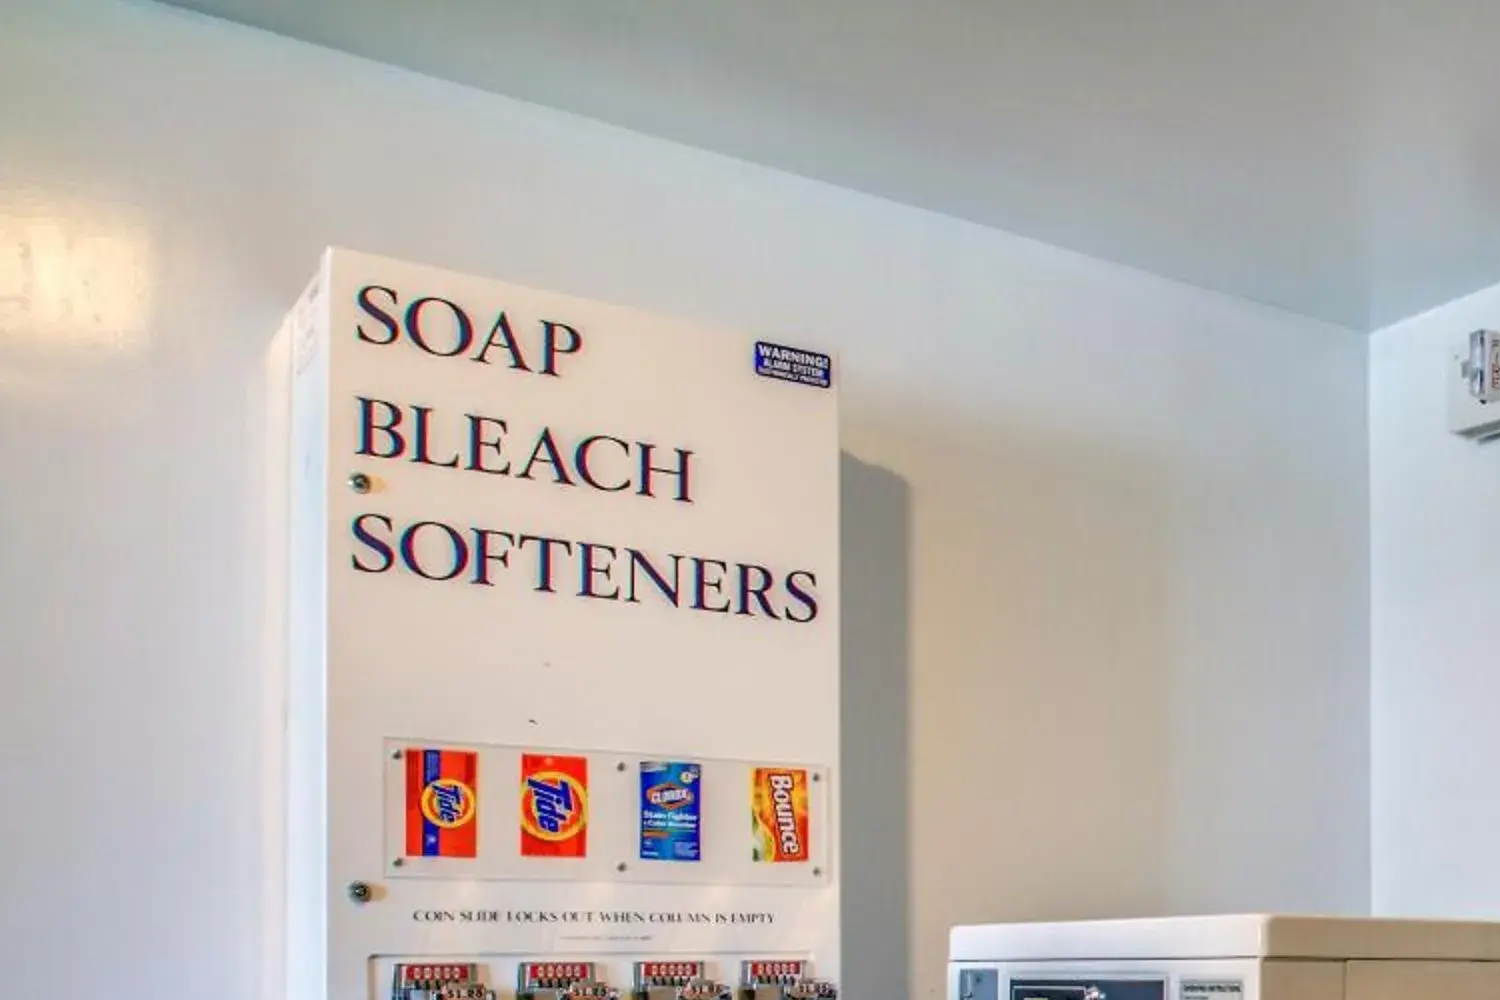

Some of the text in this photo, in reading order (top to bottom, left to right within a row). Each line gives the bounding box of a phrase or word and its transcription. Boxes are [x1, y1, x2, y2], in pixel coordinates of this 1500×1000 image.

[356, 284, 582, 378] SOAP
[758, 344, 829, 369] WARNING!
[354, 396, 695, 503] BLEACH
[351, 512, 819, 623] SOFTENERS
[431, 783, 463, 823] Tide
[527, 777, 573, 833] Tide
[769, 774, 800, 854] Bounce
[413, 910, 455, 923] COIN
[460, 910, 500, 923] SLIDE
[507, 910, 558, 923] LOCKS
[562, 910, 592, 923] OUT
[600, 912, 645, 923] WHEN
[715, 912, 727, 924] IS
[731, 912, 774, 924] EMPTY
